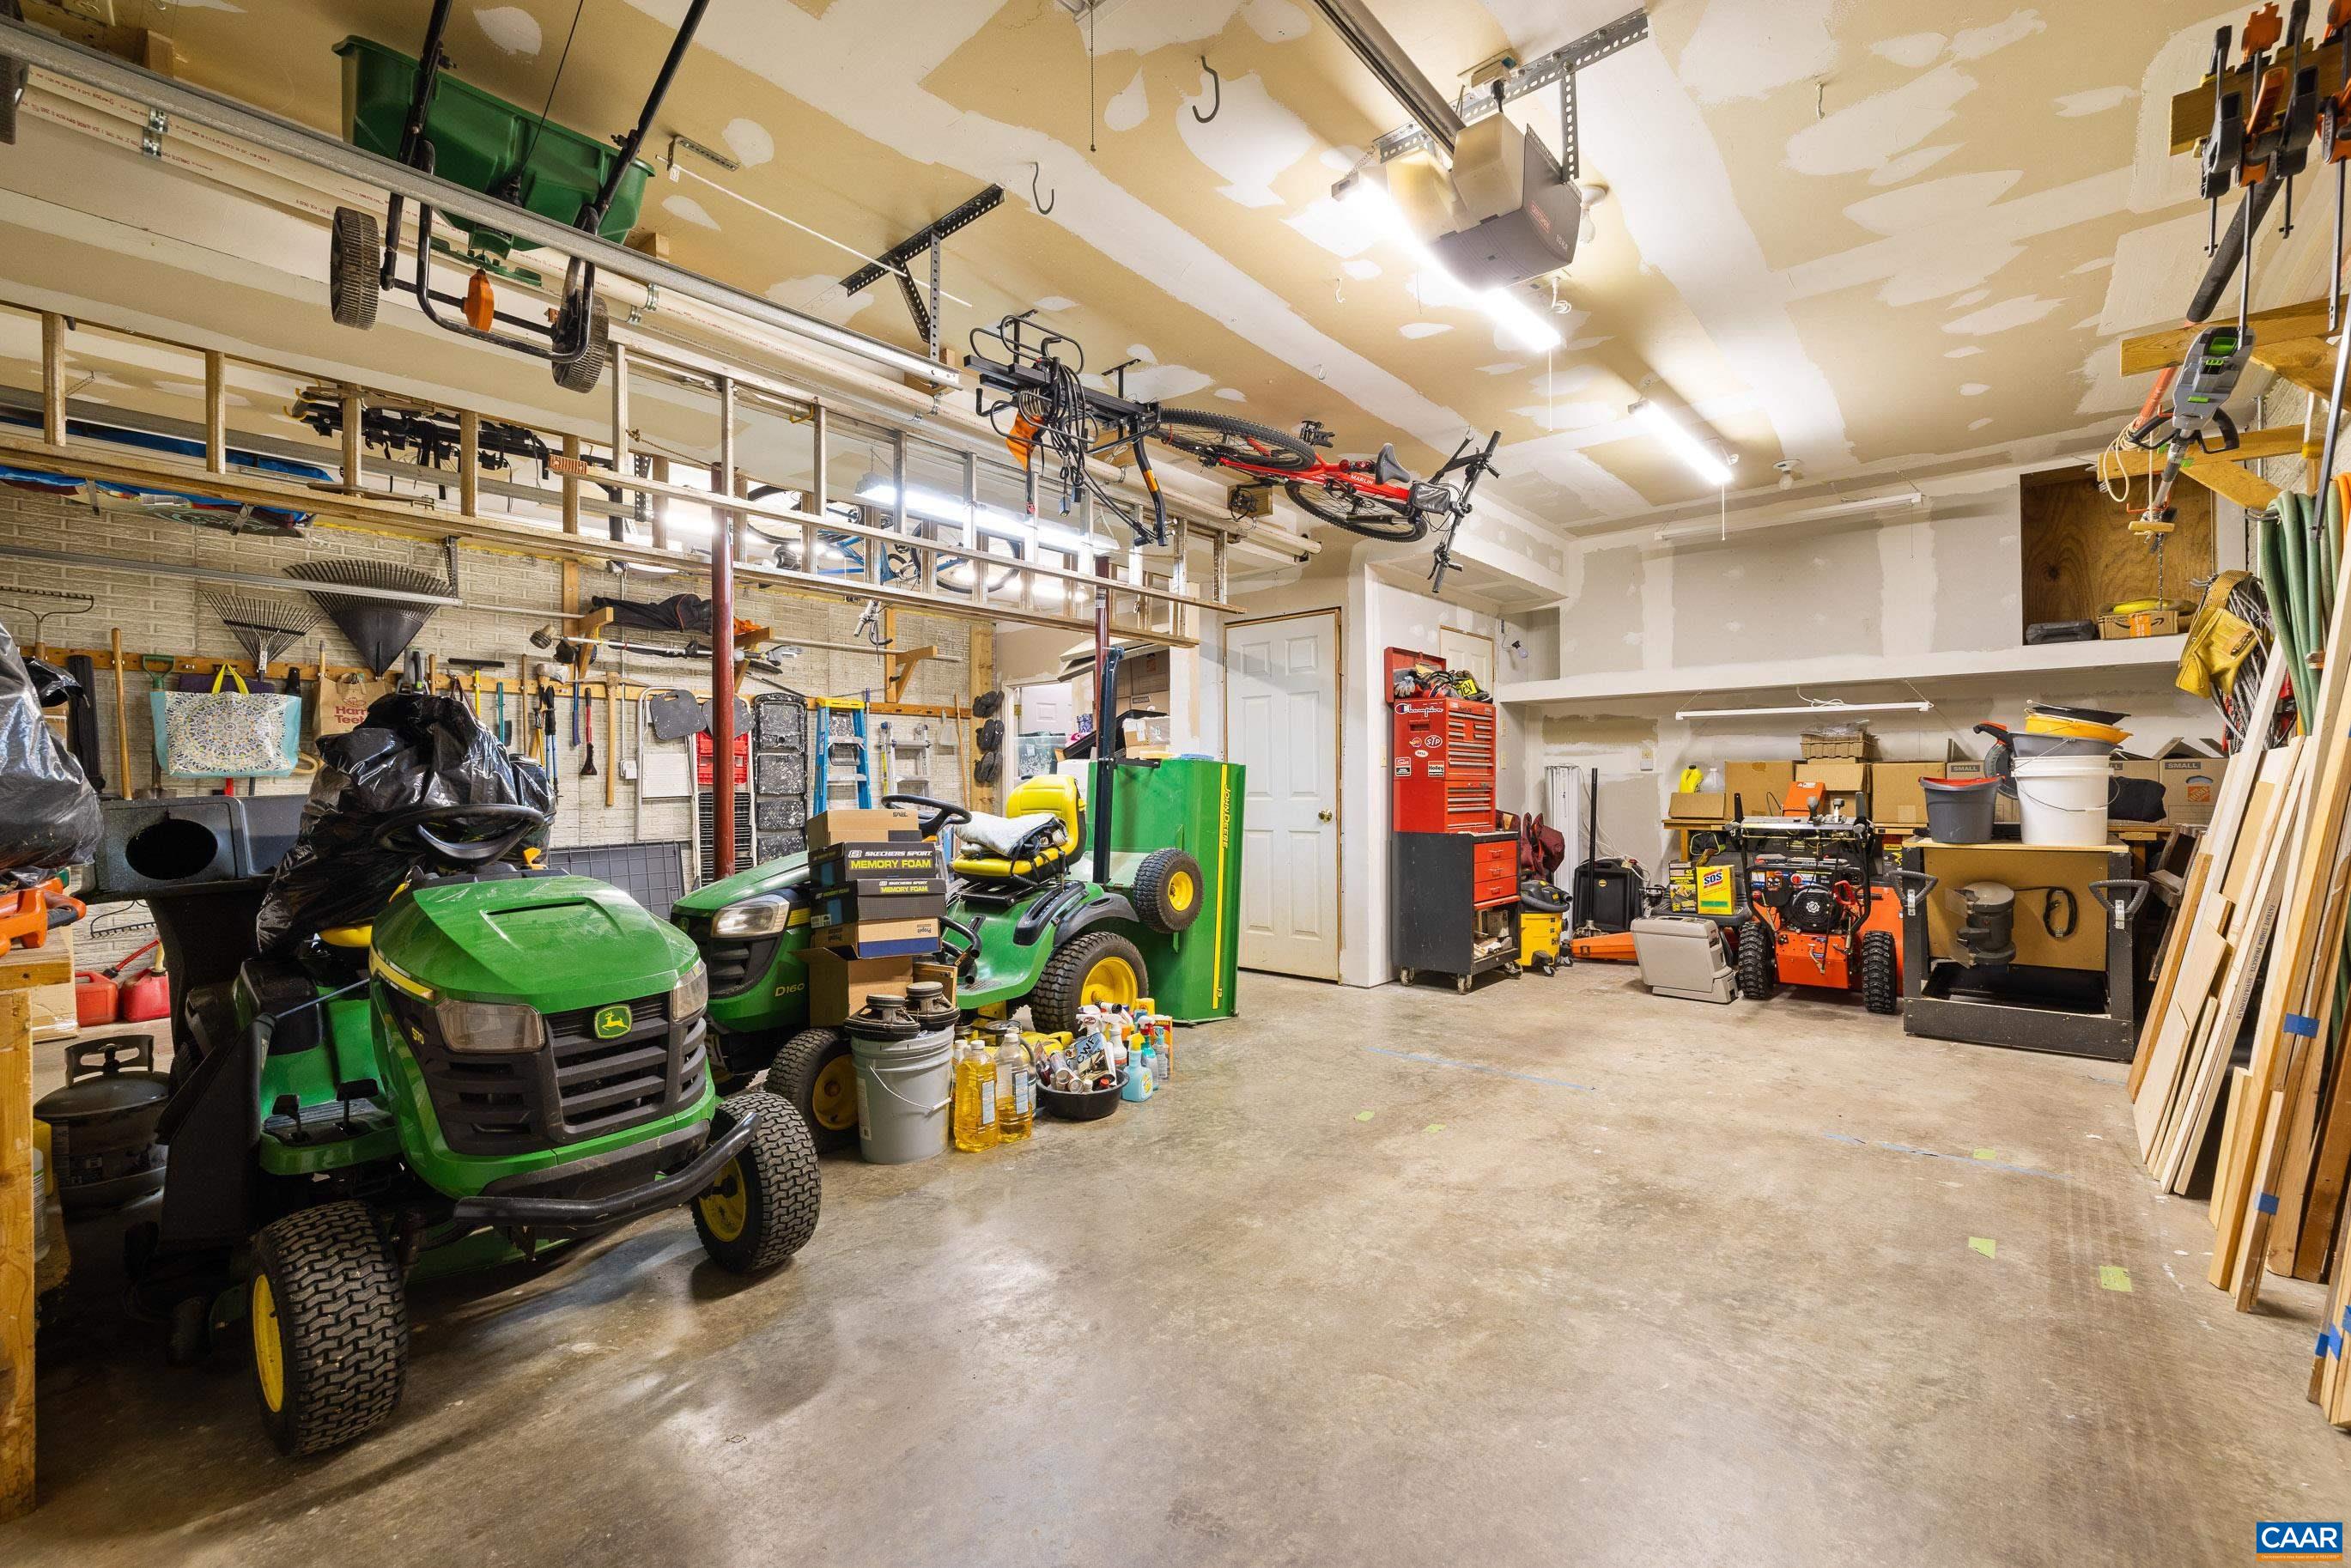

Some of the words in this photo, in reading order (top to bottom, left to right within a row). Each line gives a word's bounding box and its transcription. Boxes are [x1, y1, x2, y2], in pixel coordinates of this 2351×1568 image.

[1351, 475, 1374, 485] MARLIN
[335, 706, 368, 715] Harr
[1394, 702, 1444, 718] Champion
[334, 714, 365, 724] Teet
[1426, 737, 1440, 746] STP
[850, 860, 899, 869] MEMORY
[902, 859, 932, 869] FOAM
[775, 982, 805, 997] D160
[1076, 1036, 1096, 1065] CWF
